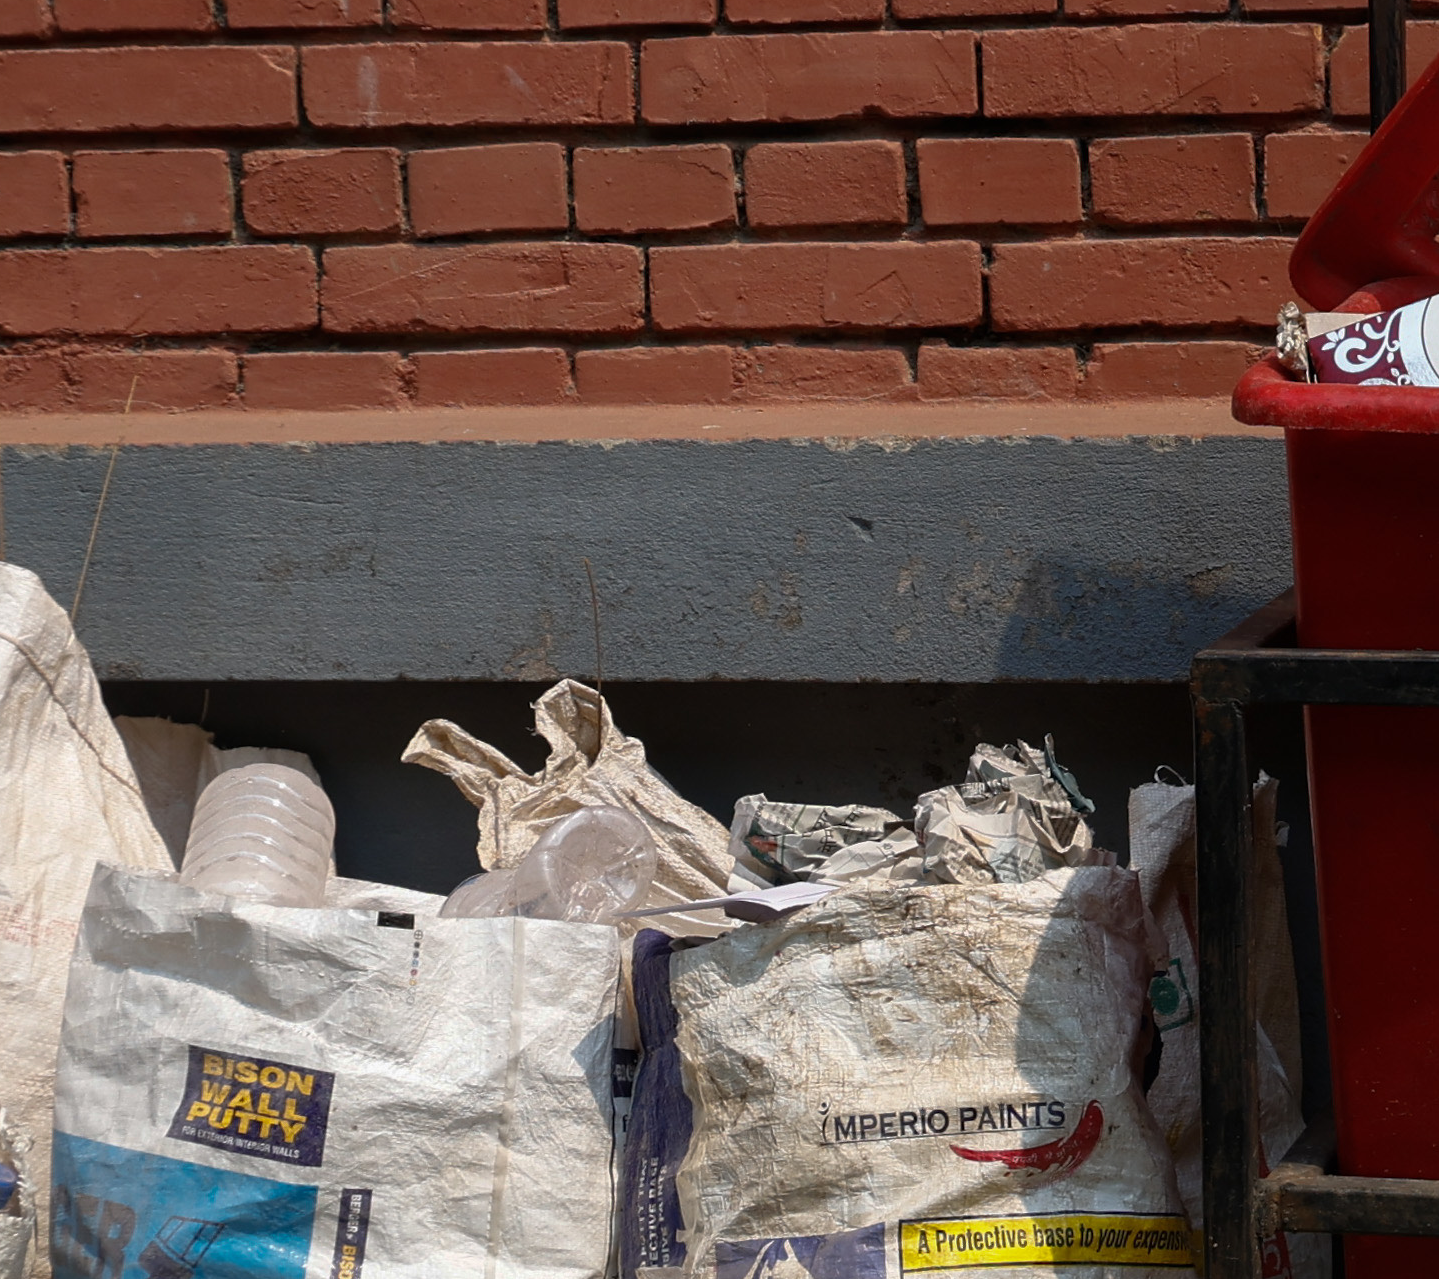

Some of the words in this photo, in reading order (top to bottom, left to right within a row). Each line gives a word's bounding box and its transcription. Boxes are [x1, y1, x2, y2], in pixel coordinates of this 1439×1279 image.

[202, 1053, 315, 1096] BISON
[201, 1079, 307, 1122] WALL
[959, 1101, 1066, 1133] PAINTS
[185, 1100, 306, 1145] PUTTY
[917, 1230, 930, 1255] A
[936, 1224, 1028, 1253] Protective
[1033, 1224, 1075, 1249] base
[1079, 1222, 1093, 1245] to
[1096, 1226, 1134, 1253] your
